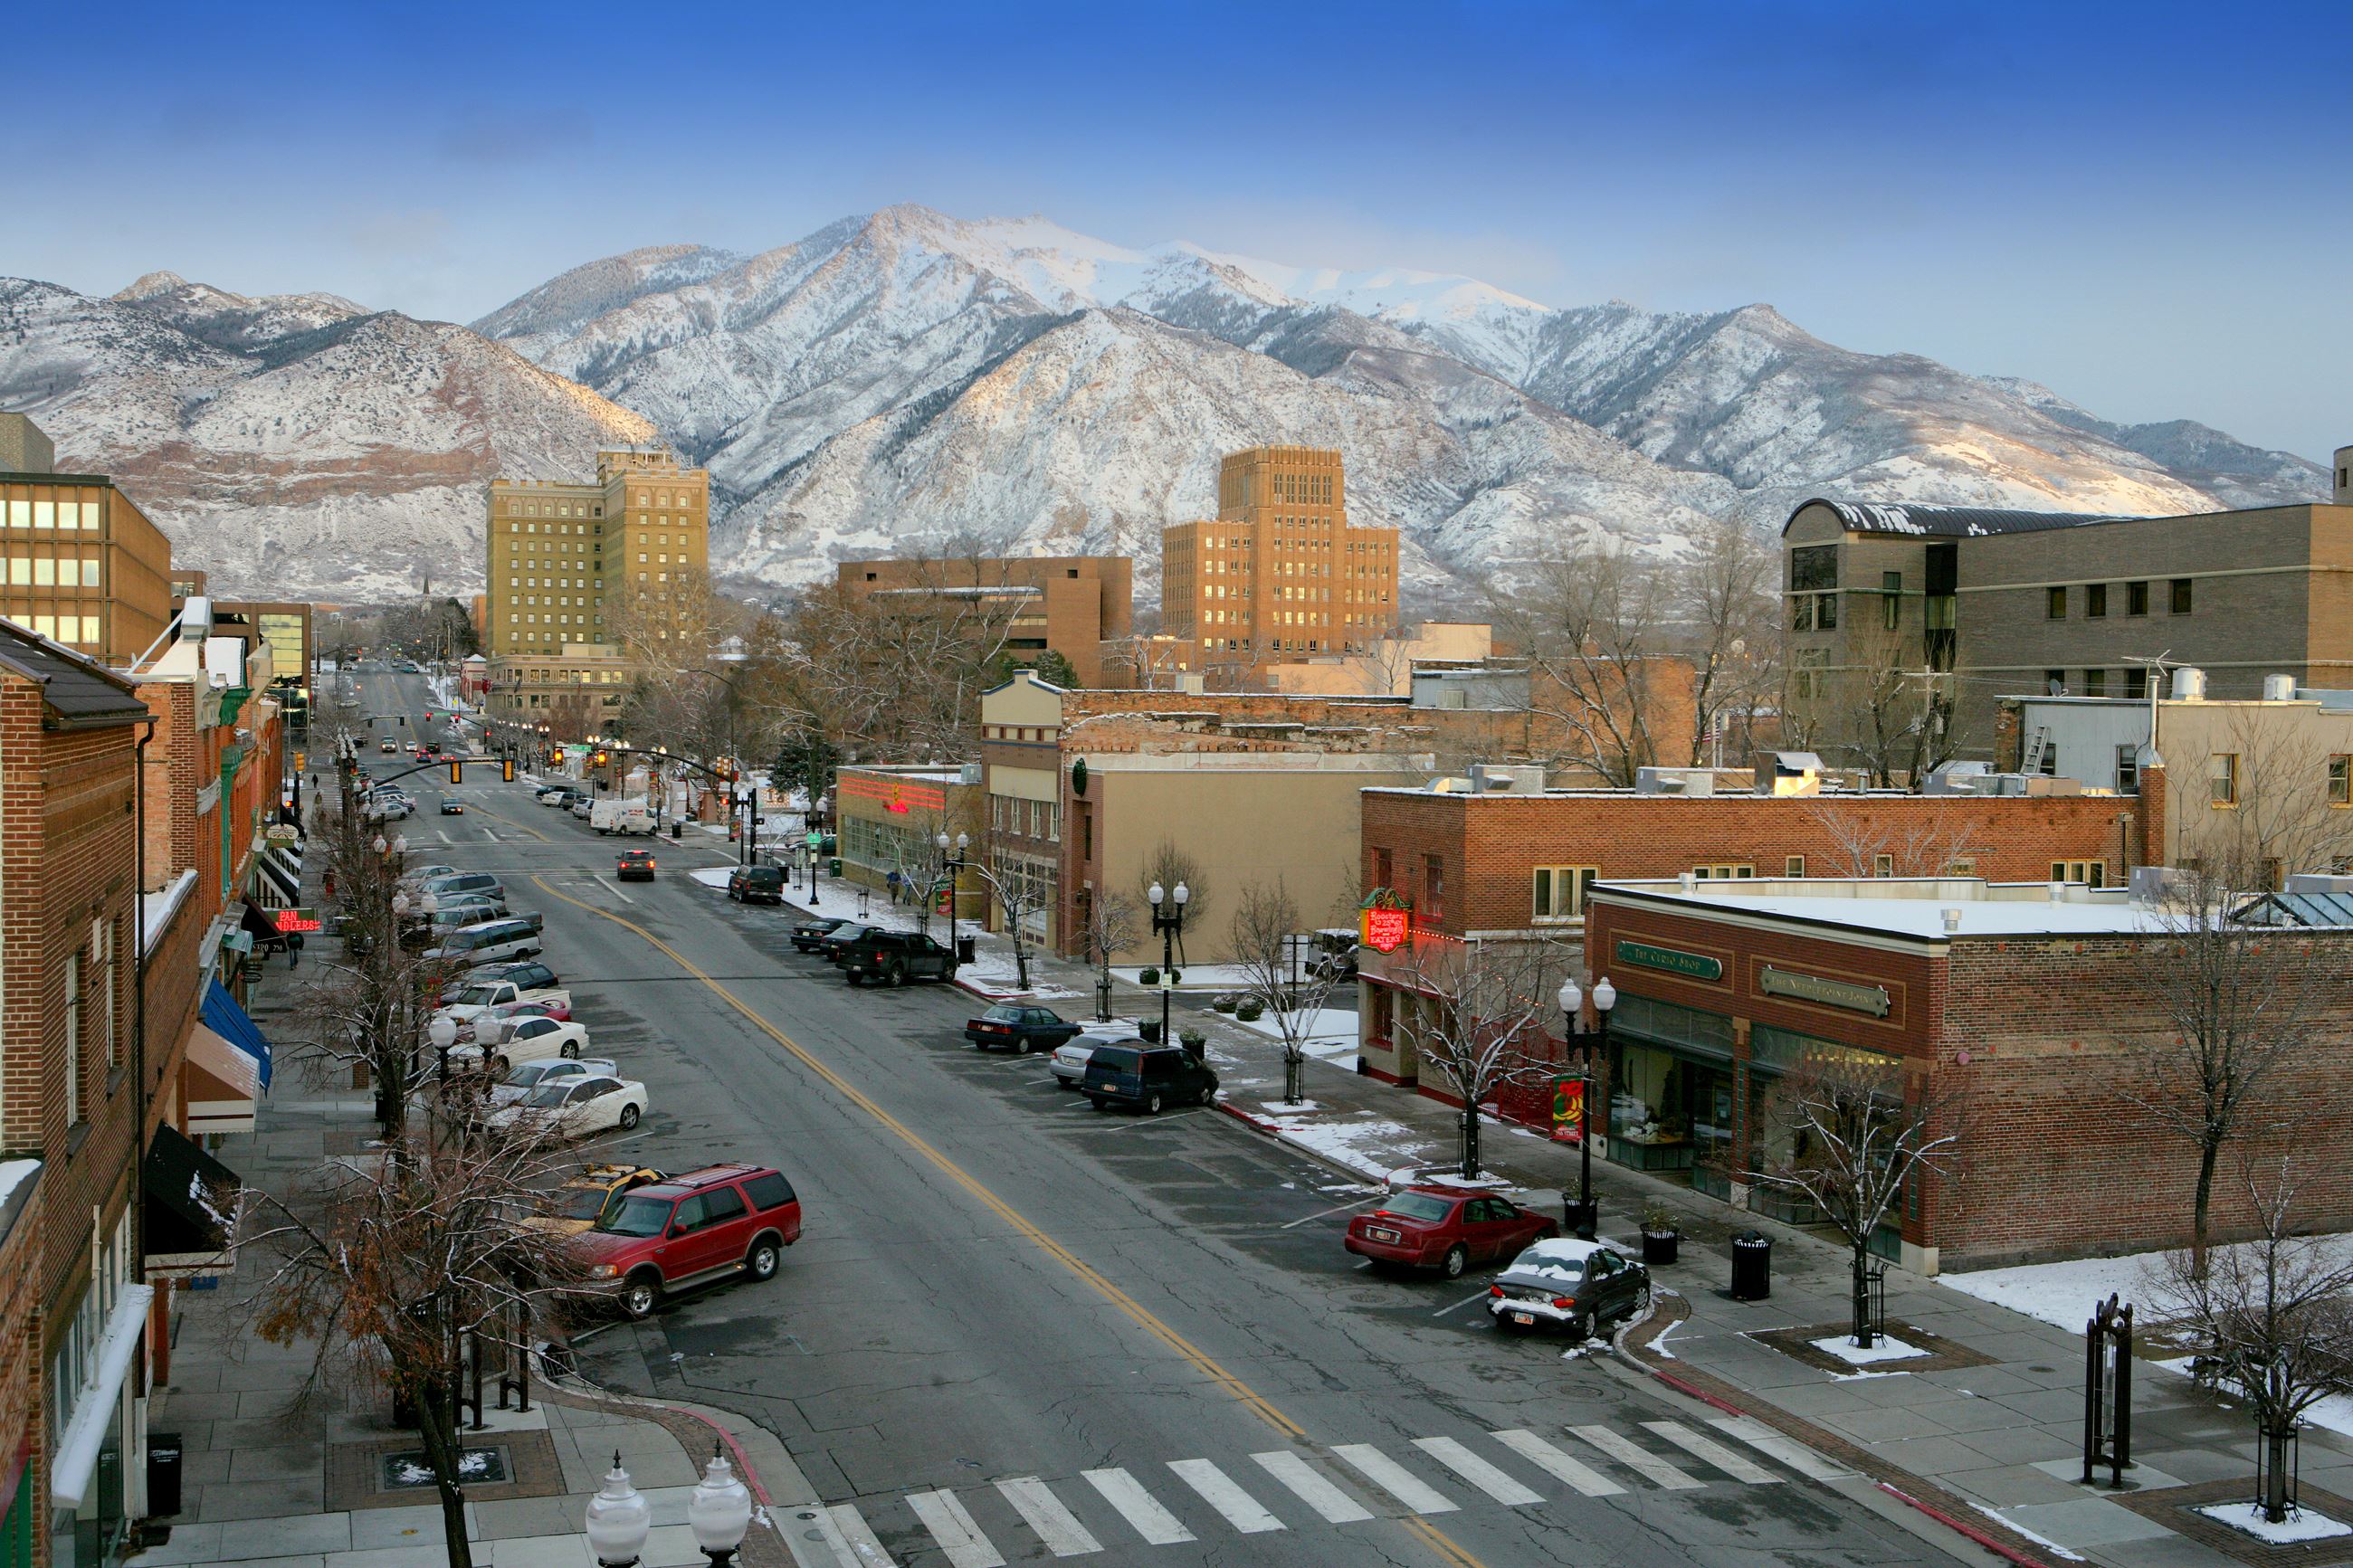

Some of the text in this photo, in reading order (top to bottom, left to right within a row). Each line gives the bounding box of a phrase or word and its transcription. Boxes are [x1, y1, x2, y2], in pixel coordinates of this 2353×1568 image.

[279, 910, 298, 921] PAN
[1370, 911, 1404, 925] Roosters
[1370, 935, 1400, 943] EATERY
[1635, 948, 1700, 971] THE CURIO SHOP
[1771, 976, 1786, 986] THE
